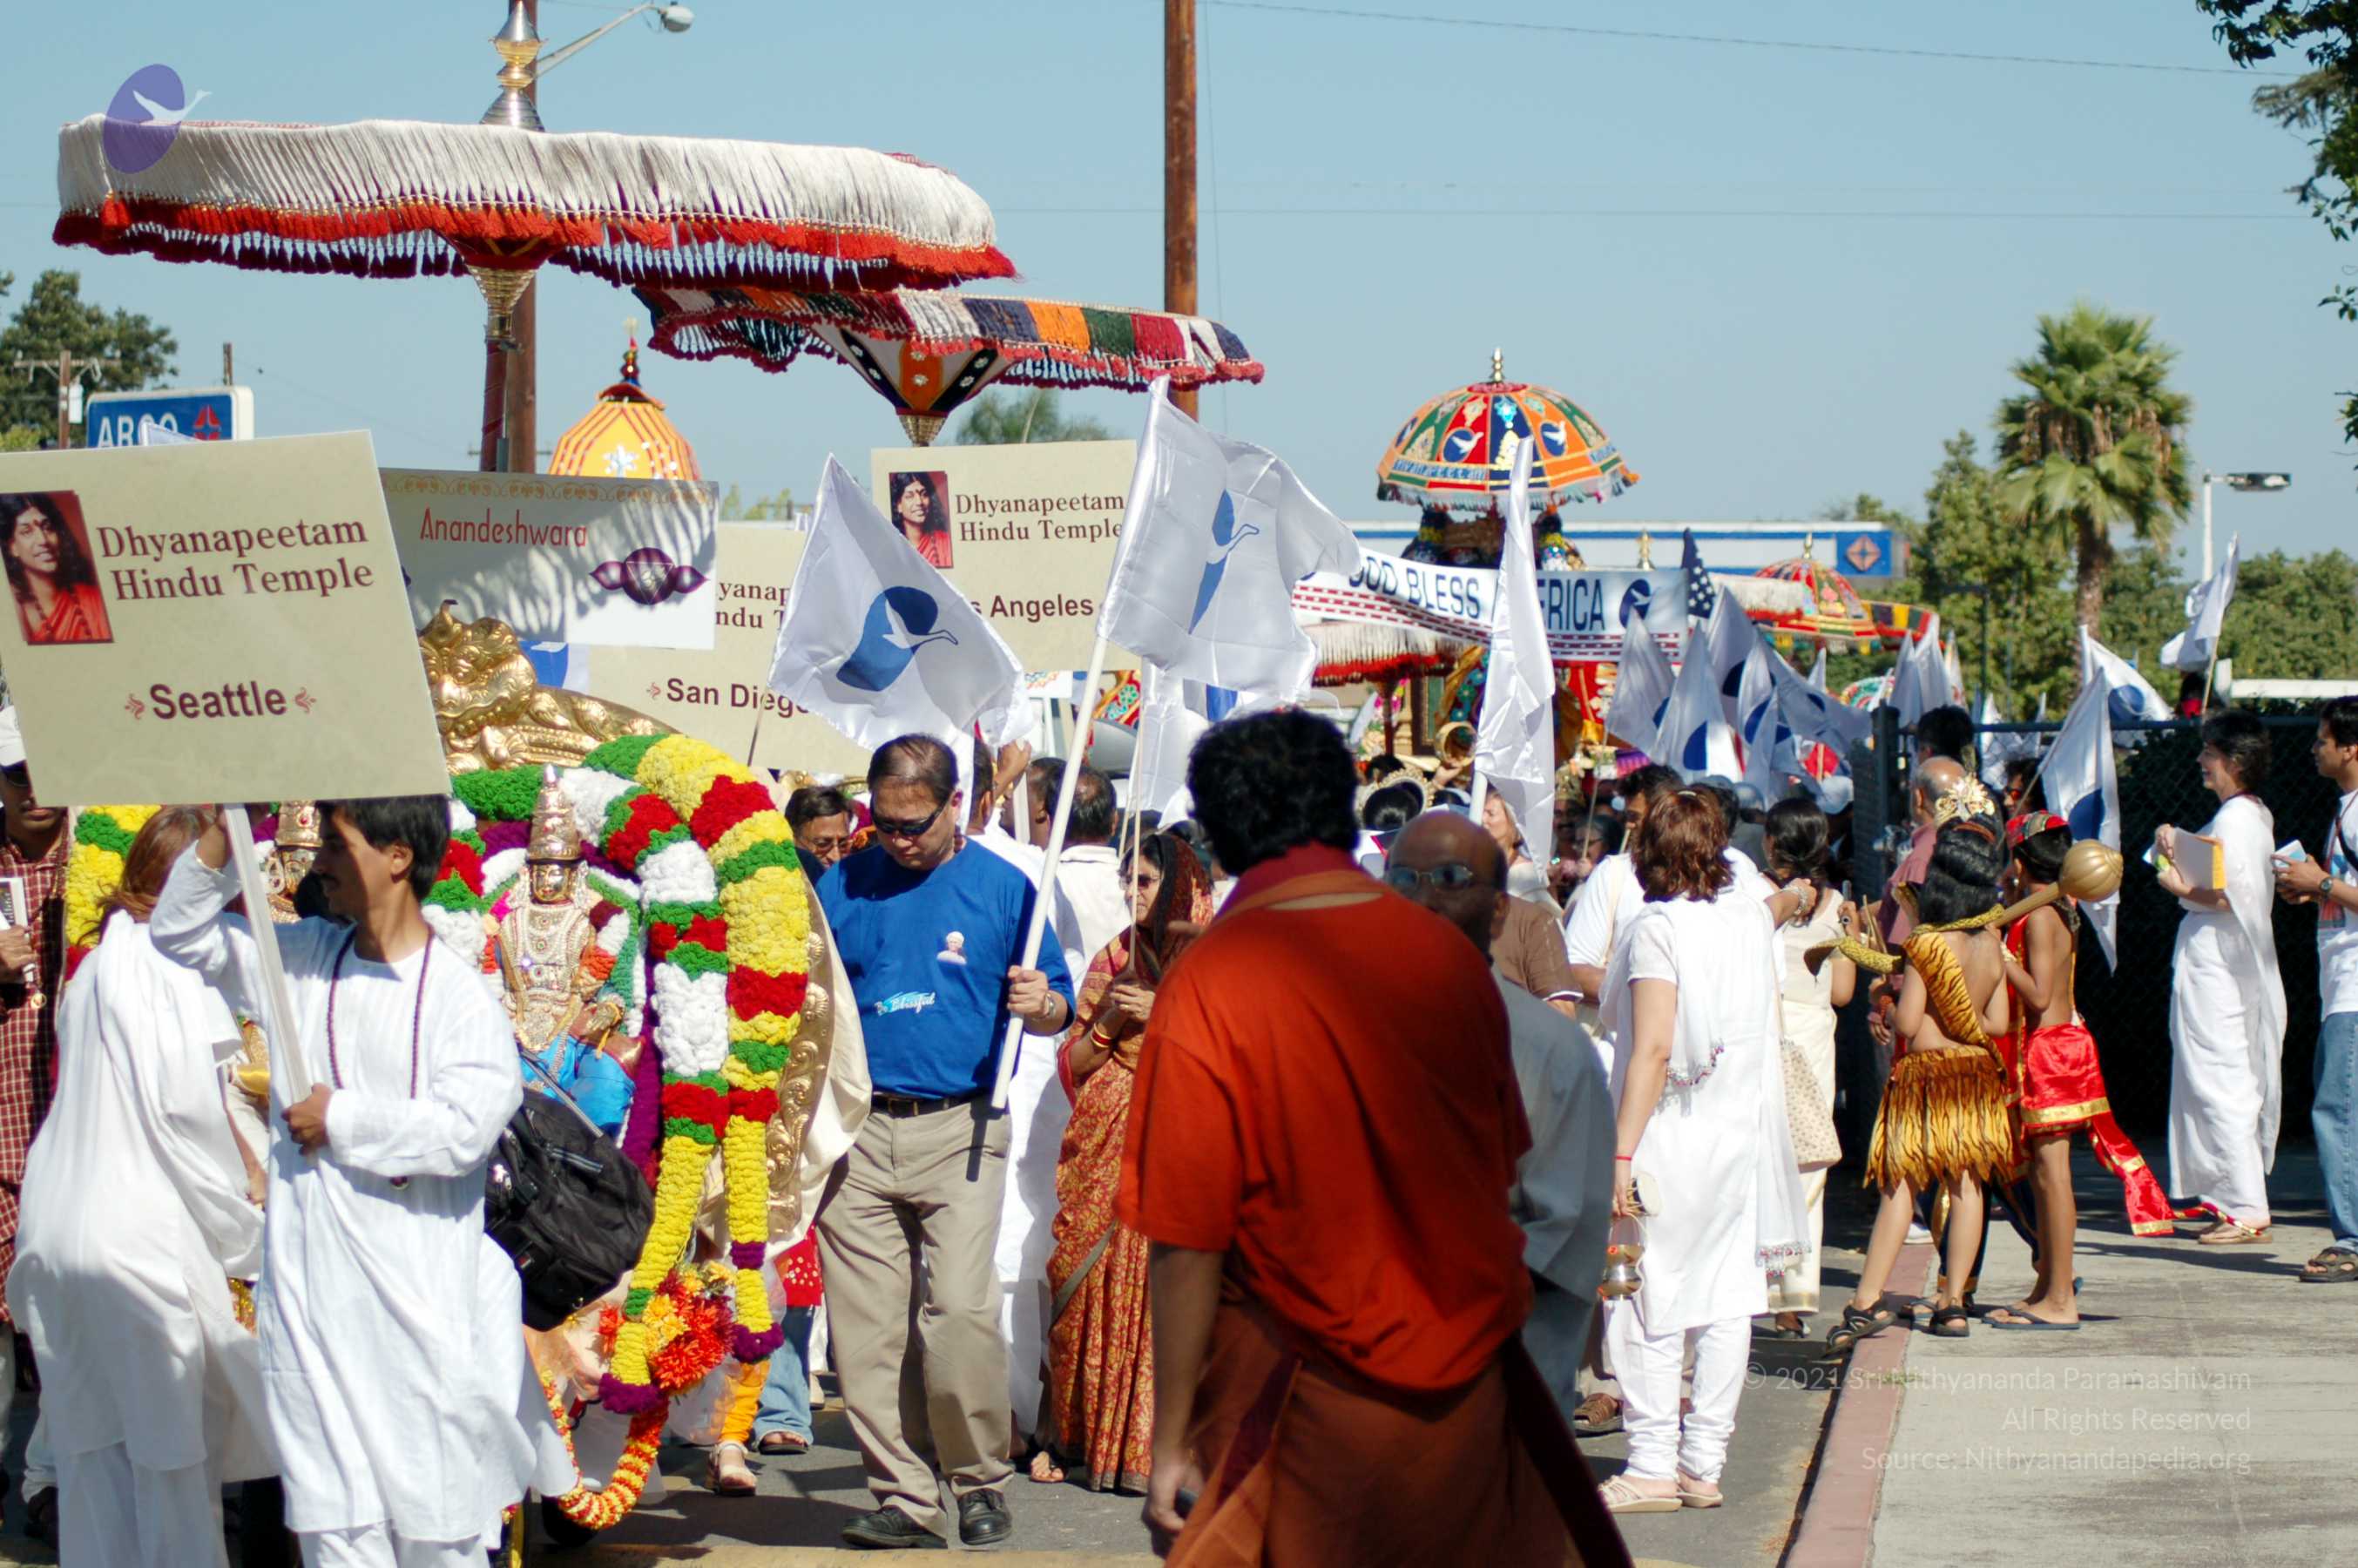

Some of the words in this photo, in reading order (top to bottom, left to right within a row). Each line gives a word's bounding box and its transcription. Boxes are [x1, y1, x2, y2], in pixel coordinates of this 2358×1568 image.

[956, 493, 1125, 517] Dhyanapeetam
[96, 519, 368, 562] Dhyanapeetam
[420, 505, 587, 547] Anandeshwara
[960, 521, 1030, 542] Hindu
[1037, 518, 1122, 543] Temple
[111, 566, 225, 600] Hindu
[233, 558, 374, 597] Temple
[990, 594, 1093, 623] Angeles
[1406, 568, 1479, 618] BLESS
[1537, 578, 1605, 632] RICA
[716, 607, 763, 628] ndu
[150, 680, 287, 720] Seattle
[666, 678, 719, 706] San
